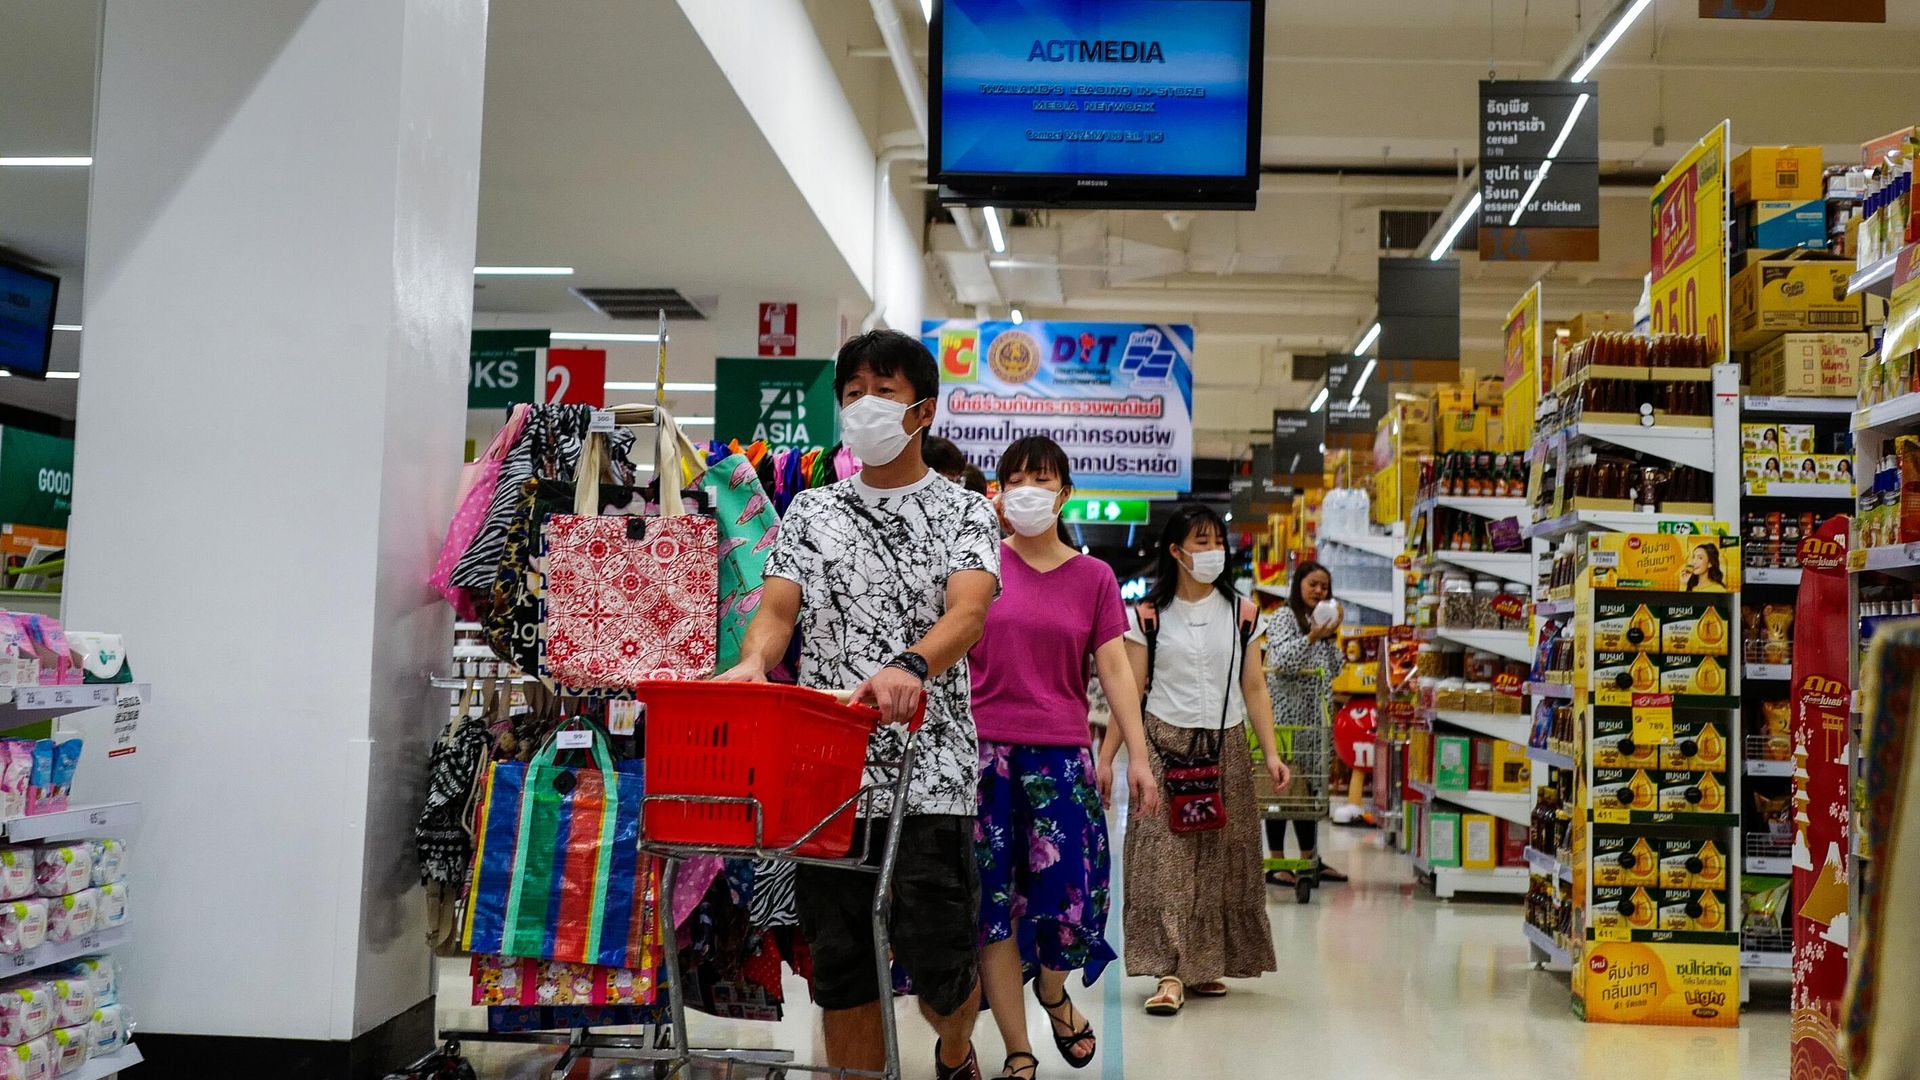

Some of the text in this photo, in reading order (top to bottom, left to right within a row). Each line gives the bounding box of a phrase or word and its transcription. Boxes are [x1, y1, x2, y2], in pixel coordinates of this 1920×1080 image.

[1028, 39, 1163, 62] ACTMEDIA
[1084, 102, 1156, 112] NETWORK
[1486, 134, 1518, 144] cereal
[1528, 201, 1539, 212] of
[1541, 201, 1581, 212] chicken
[1489, 229, 1528, 261] 14
[469, 359, 519, 388] KS
[751, 423, 810, 443] ASIA
[39, 468, 71, 495] GOOD
[1600, 694, 1616, 702] 411
[1649, 722, 1664, 730] 789
[1597, 811, 1613, 819] 411
[1598, 930, 1613, 938] 411
[1609, 961, 1649, 980] ดื่มง่าย
[1677, 960, 1731, 978] ซุปไก่สกัด
[1602, 981, 1657, 1000] กลิ่นเบาๆ
[1685, 989, 1725, 1006] Light
